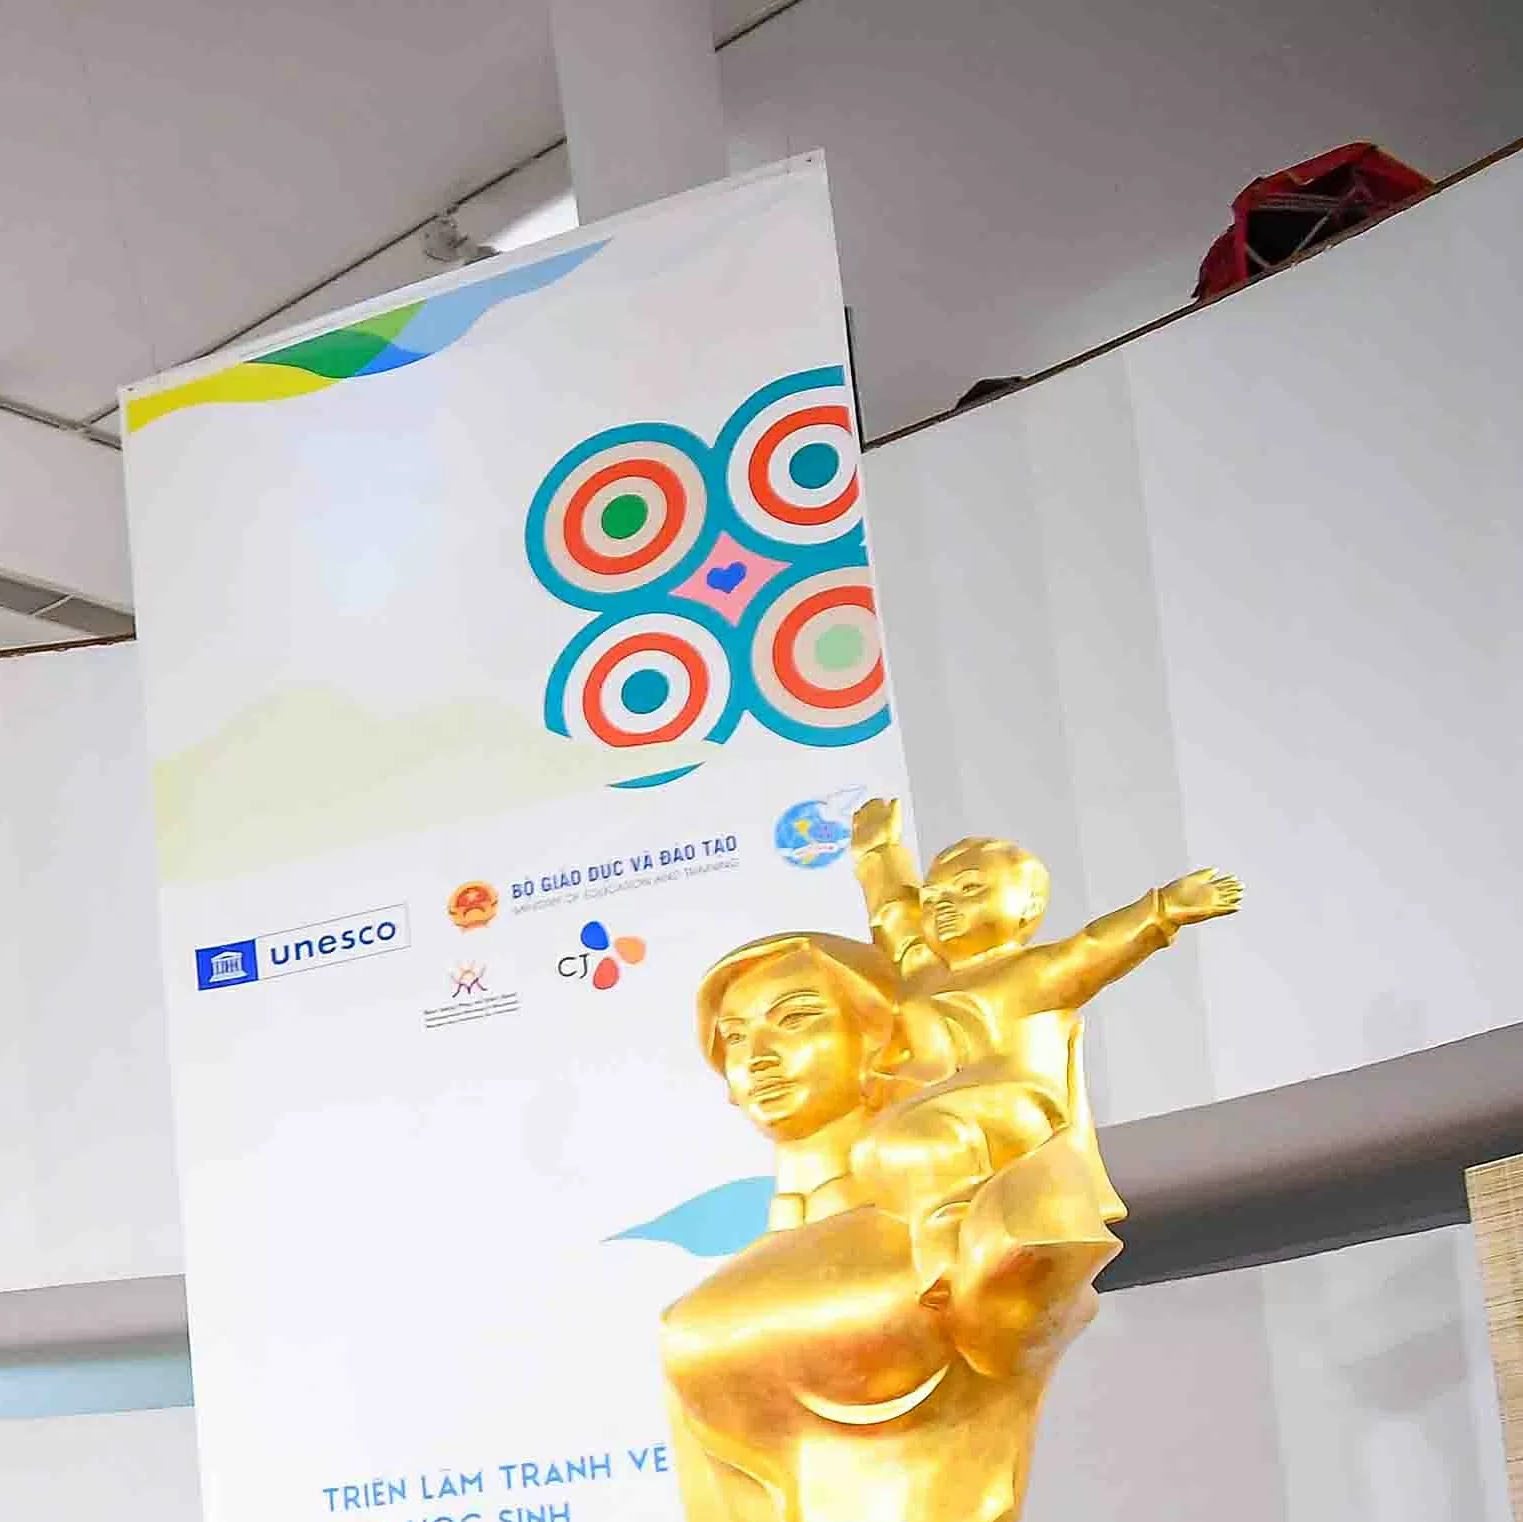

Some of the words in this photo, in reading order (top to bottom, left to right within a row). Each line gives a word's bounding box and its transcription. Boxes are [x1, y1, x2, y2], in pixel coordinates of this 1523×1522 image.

[269, 917, 397, 966] unesco
[557, 954, 591, 980] CJ
[499, 1453, 613, 1490] TRANH
